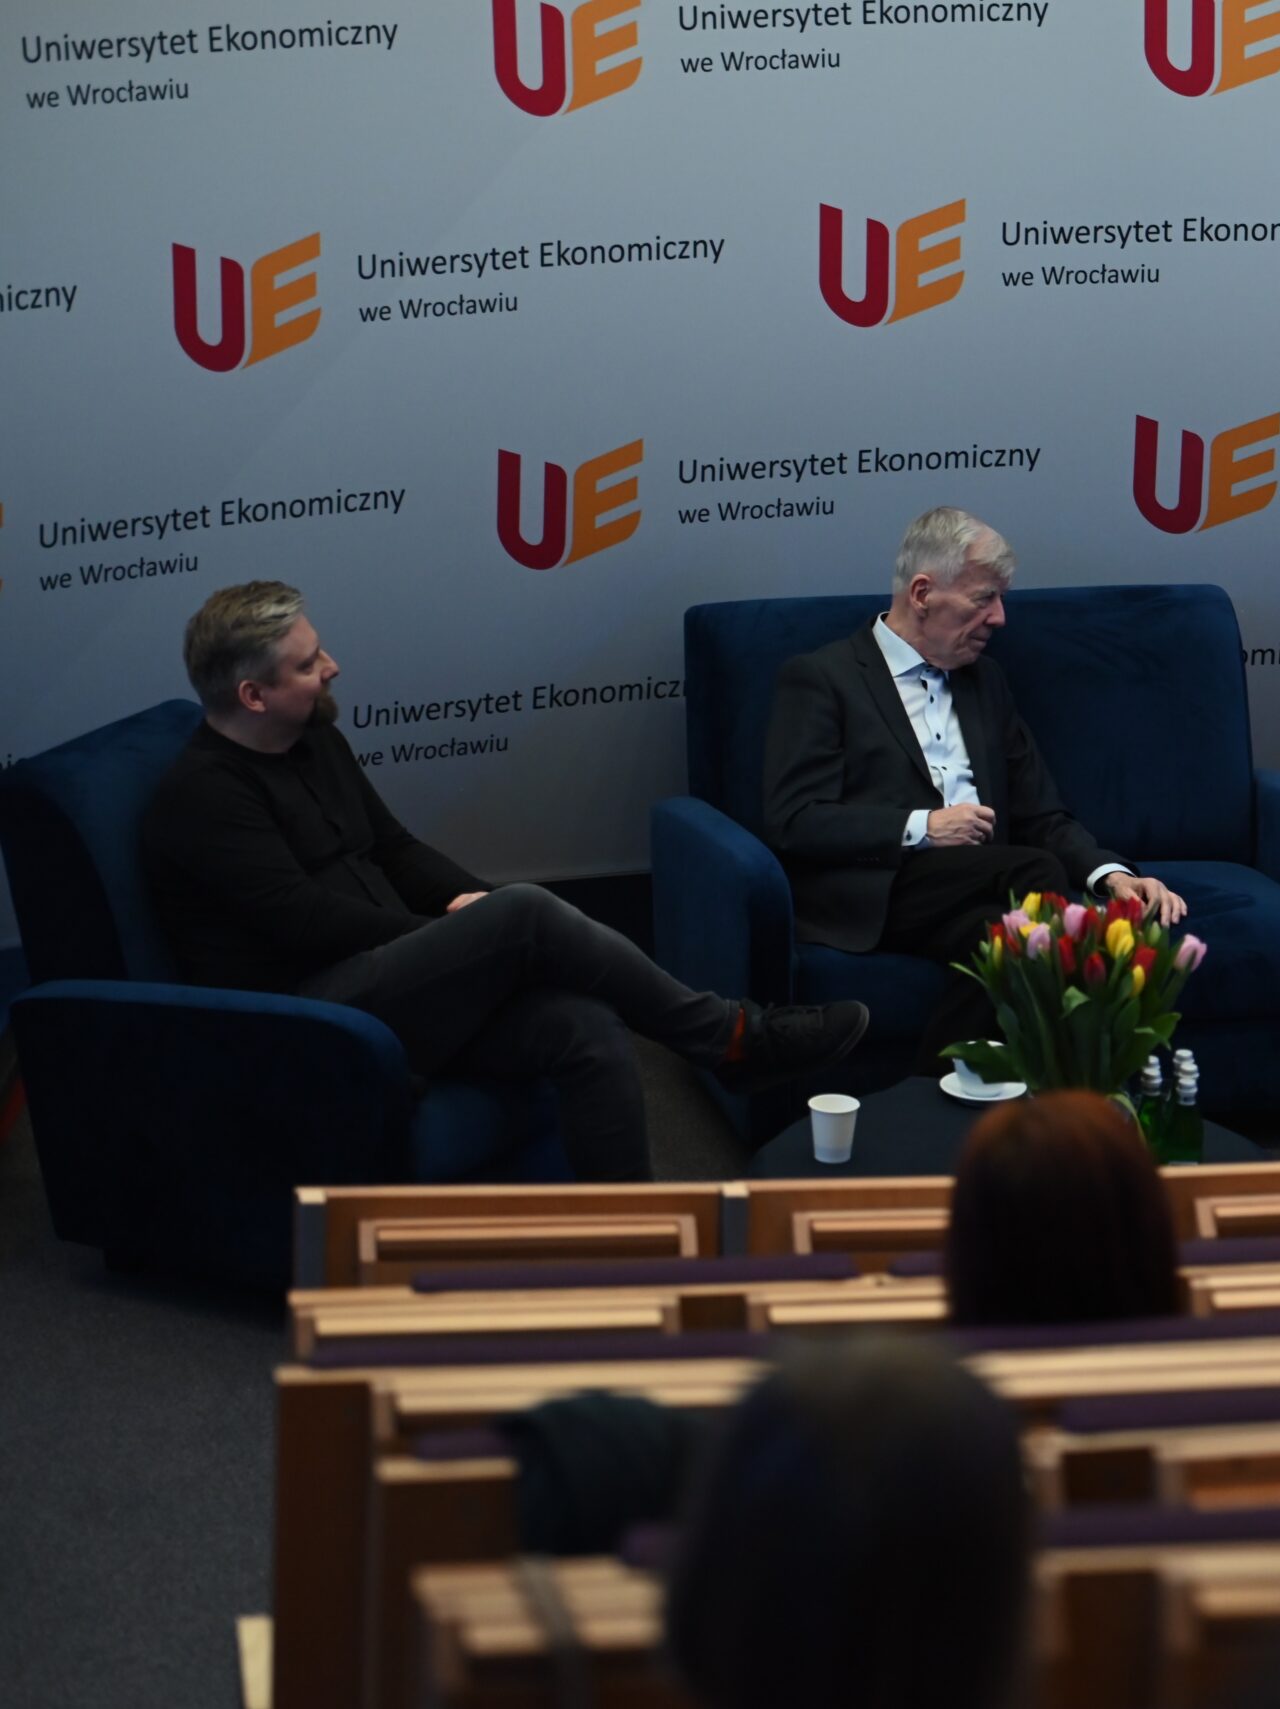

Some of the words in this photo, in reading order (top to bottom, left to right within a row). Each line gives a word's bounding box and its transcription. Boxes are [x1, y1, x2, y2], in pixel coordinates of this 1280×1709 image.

[678, 2, 853, 34] Uniwersytet
[862, 0, 1049, 27] Ekonomiczny
[21, 28, 199, 64] Uniwersytet
[208, 19, 399, 53] Ekonomiczny
[492, 0, 645, 117] UE
[679, 56, 714, 74] we
[720, 47, 841, 72] Wrocławiu
[25, 90, 60, 110] we
[66, 77, 189, 107] Wrocławiu
[1001, 219, 1174, 250] Uniwersytet
[357, 245, 530, 281] Uniwersytet
[539, 235, 726, 268] Ekonomiczny
[819, 198, 968, 329] UE
[1001, 271, 1035, 287] we
[1041, 263, 1160, 286] Wrocławiu
[172, 231, 322, 372] UE
[358, 305, 392, 323] we
[398, 291, 518, 320] Wrocławiu
[678, 452, 849, 485] Uniwersytet
[857, 443, 1041, 474] Ekonomiczny
[39, 504, 211, 550] Uniwersytet
[220, 488, 406, 527] Ekonomiczny
[498, 438, 645, 570] UE
[677, 507, 711, 525] we
[717, 495, 835, 522] Wrocławiu
[39, 572, 73, 592] we
[79, 552, 199, 586] Wrocławiu
[352, 689, 524, 729] Uniwersytet
[532, 675, 685, 710] Ekonomicz
[390, 733, 509, 764] Wrocławiu
